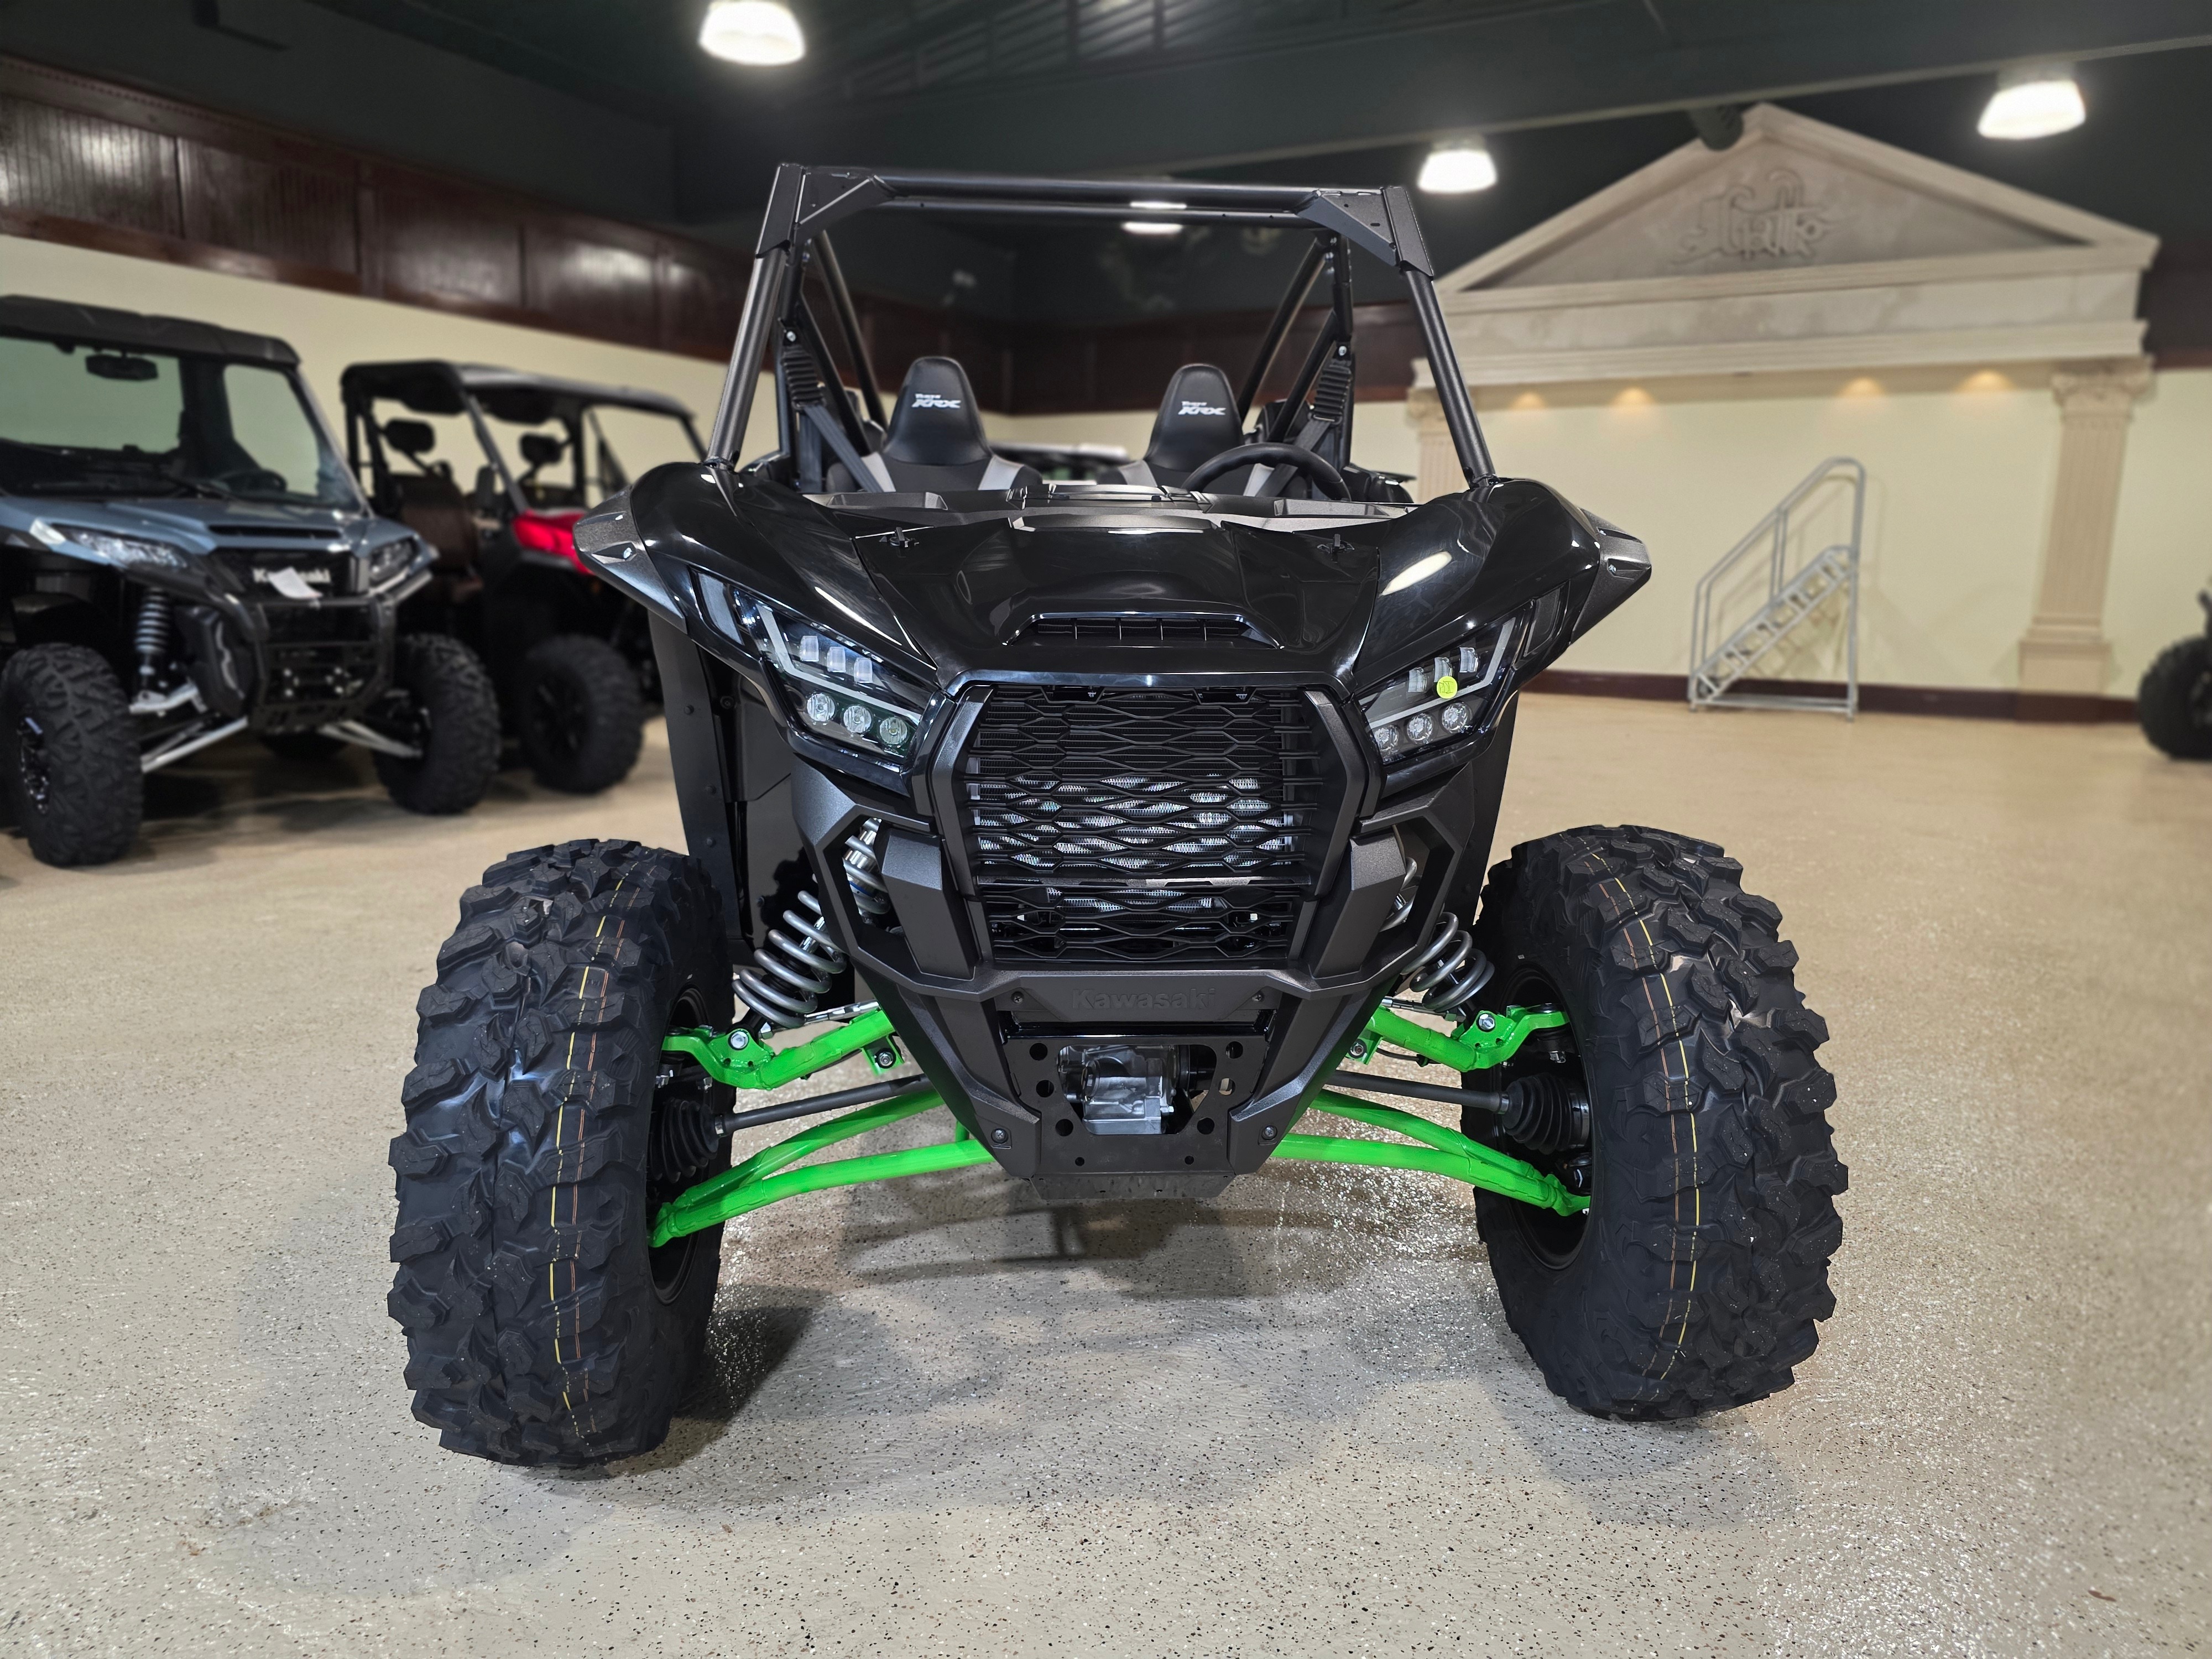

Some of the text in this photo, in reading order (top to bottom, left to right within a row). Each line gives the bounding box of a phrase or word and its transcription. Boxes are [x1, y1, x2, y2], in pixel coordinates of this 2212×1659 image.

[911, 399, 962, 408] KRX
[1178, 406, 1227, 415] KRX
[1072, 988, 1216, 1010] Kawasaki
